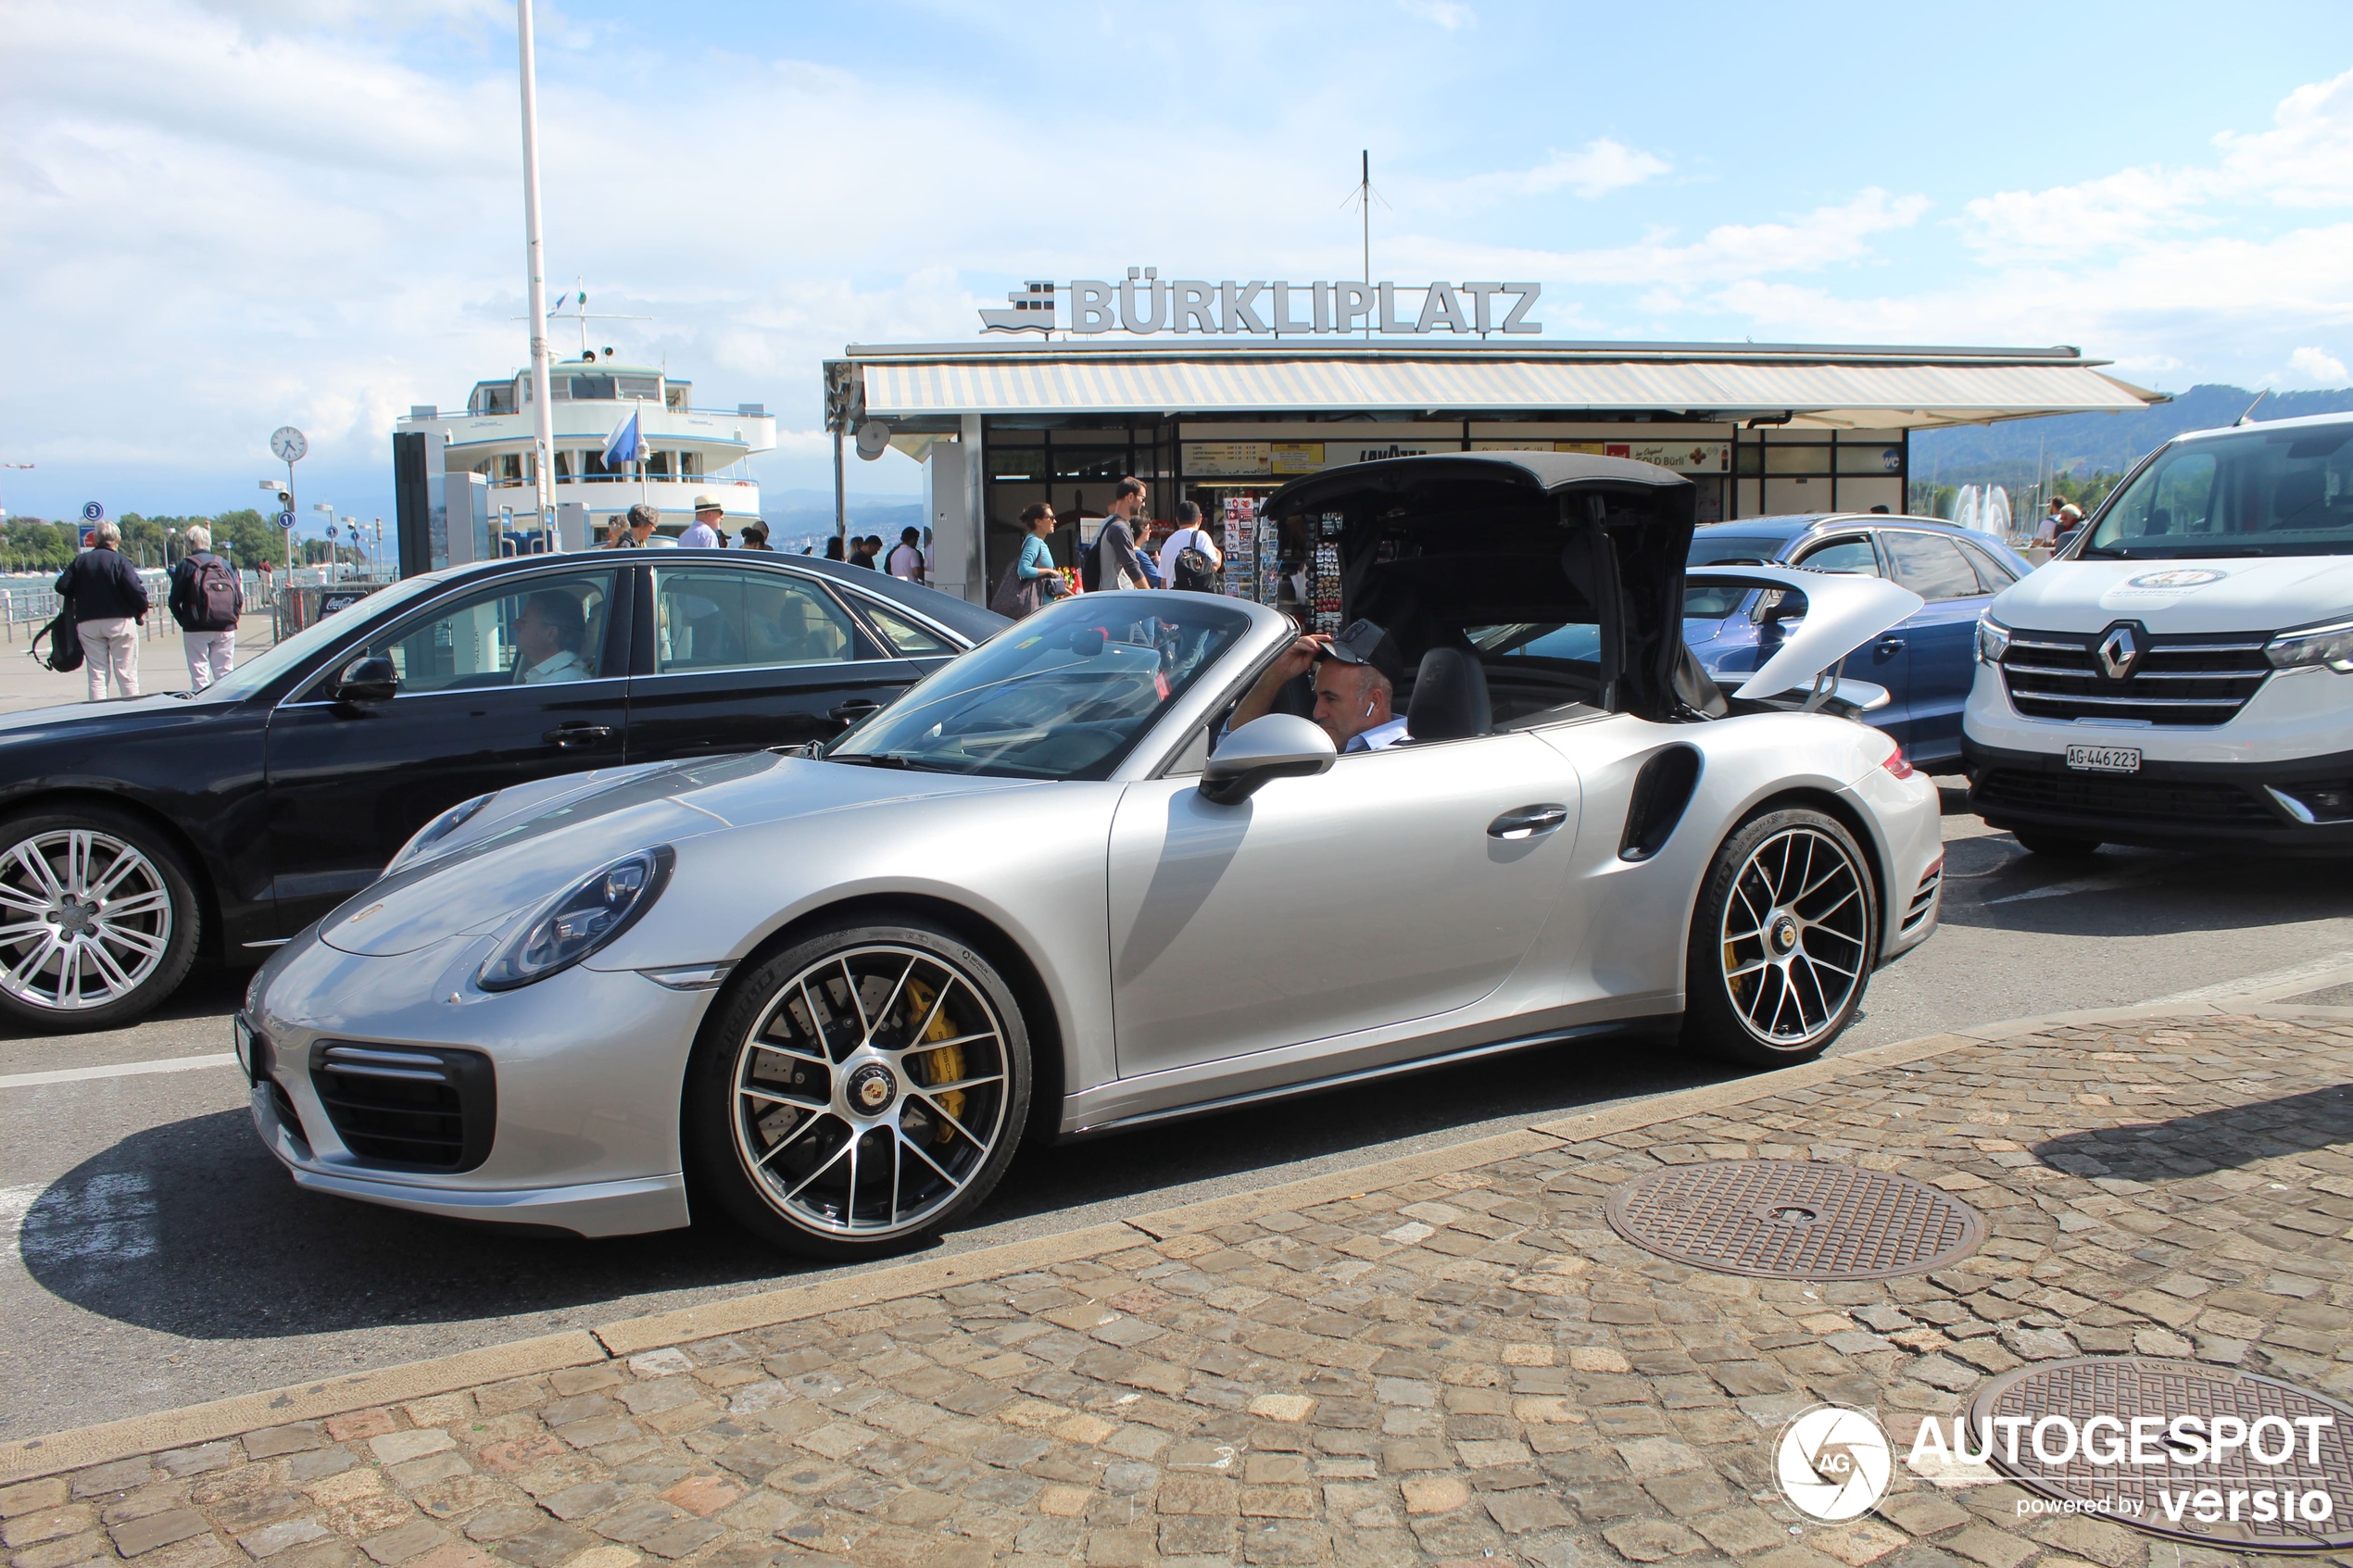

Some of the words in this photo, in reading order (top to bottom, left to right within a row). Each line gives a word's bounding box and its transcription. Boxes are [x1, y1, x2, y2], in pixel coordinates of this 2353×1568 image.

[1071, 267, 1542, 335] BÜRKLIPLATZ
[1664, 456, 1684, 466] Bürli
[1882, 456, 1900, 468] WC
[89, 506, 97, 517] 3
[1731, 840, 1745, 859] PILOT
[1745, 823, 1763, 841] SPORT
[777, 951, 799, 967] PILOT
[799, 936, 826, 953] SPORT
[937, 1031, 953, 1083] PRSCHE
[2141, 1362, 2173, 1372] VON
[2183, 1366, 2225, 1380] ROLL
